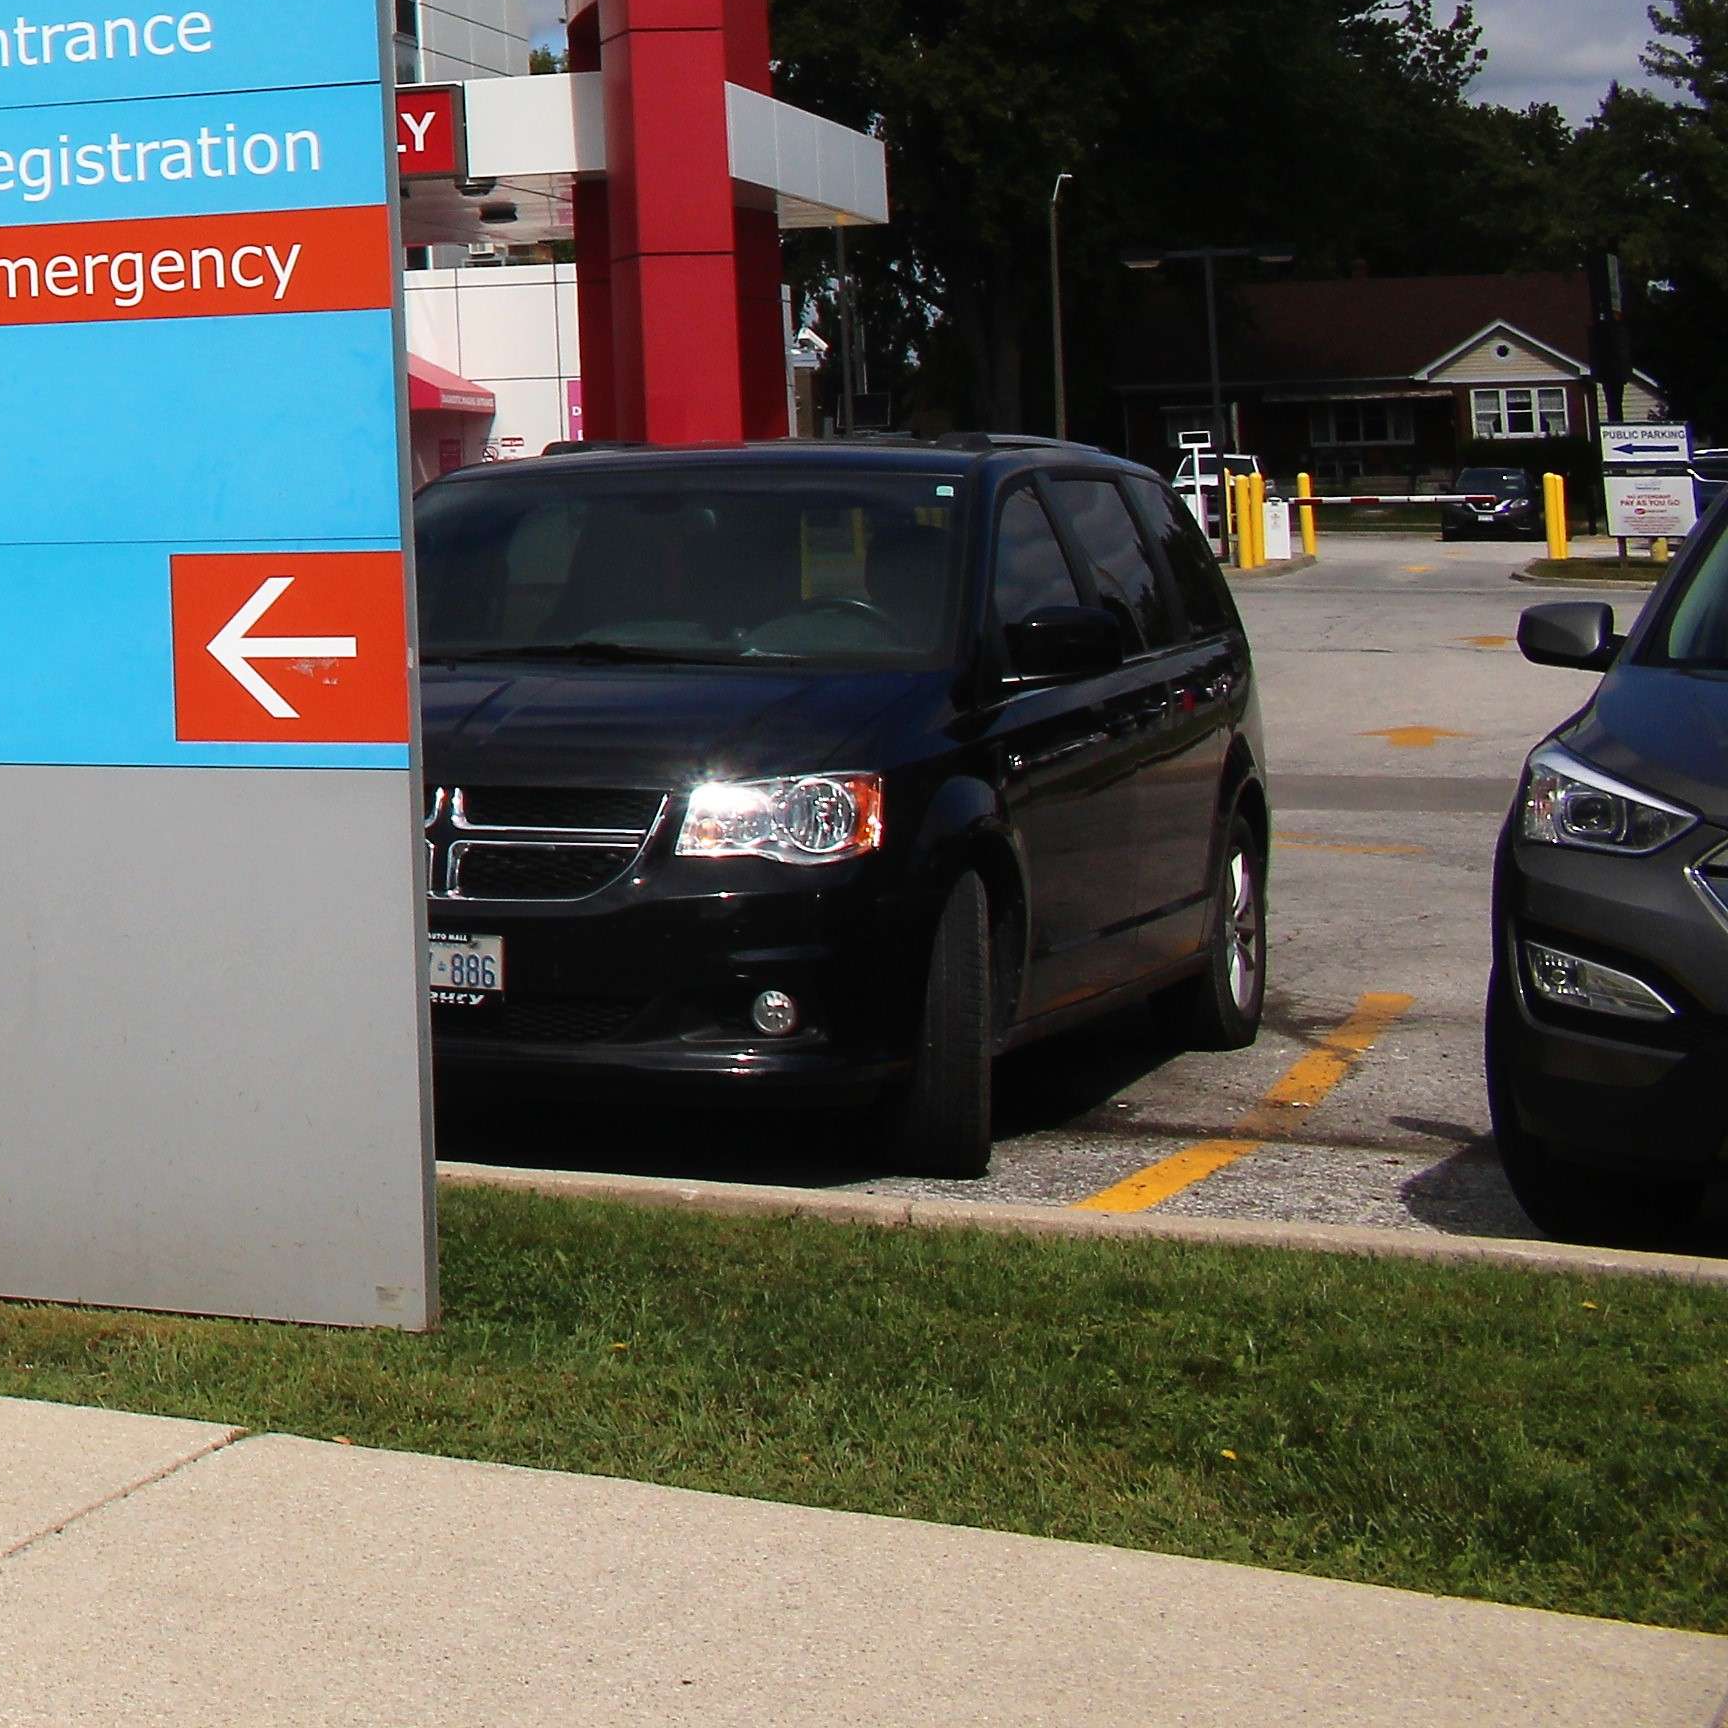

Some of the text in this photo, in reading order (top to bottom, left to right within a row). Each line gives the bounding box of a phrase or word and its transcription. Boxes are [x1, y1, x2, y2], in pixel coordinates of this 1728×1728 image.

[396, 111, 436, 153] Y
[1602, 430, 1686, 440] PUBLIC PARKING
